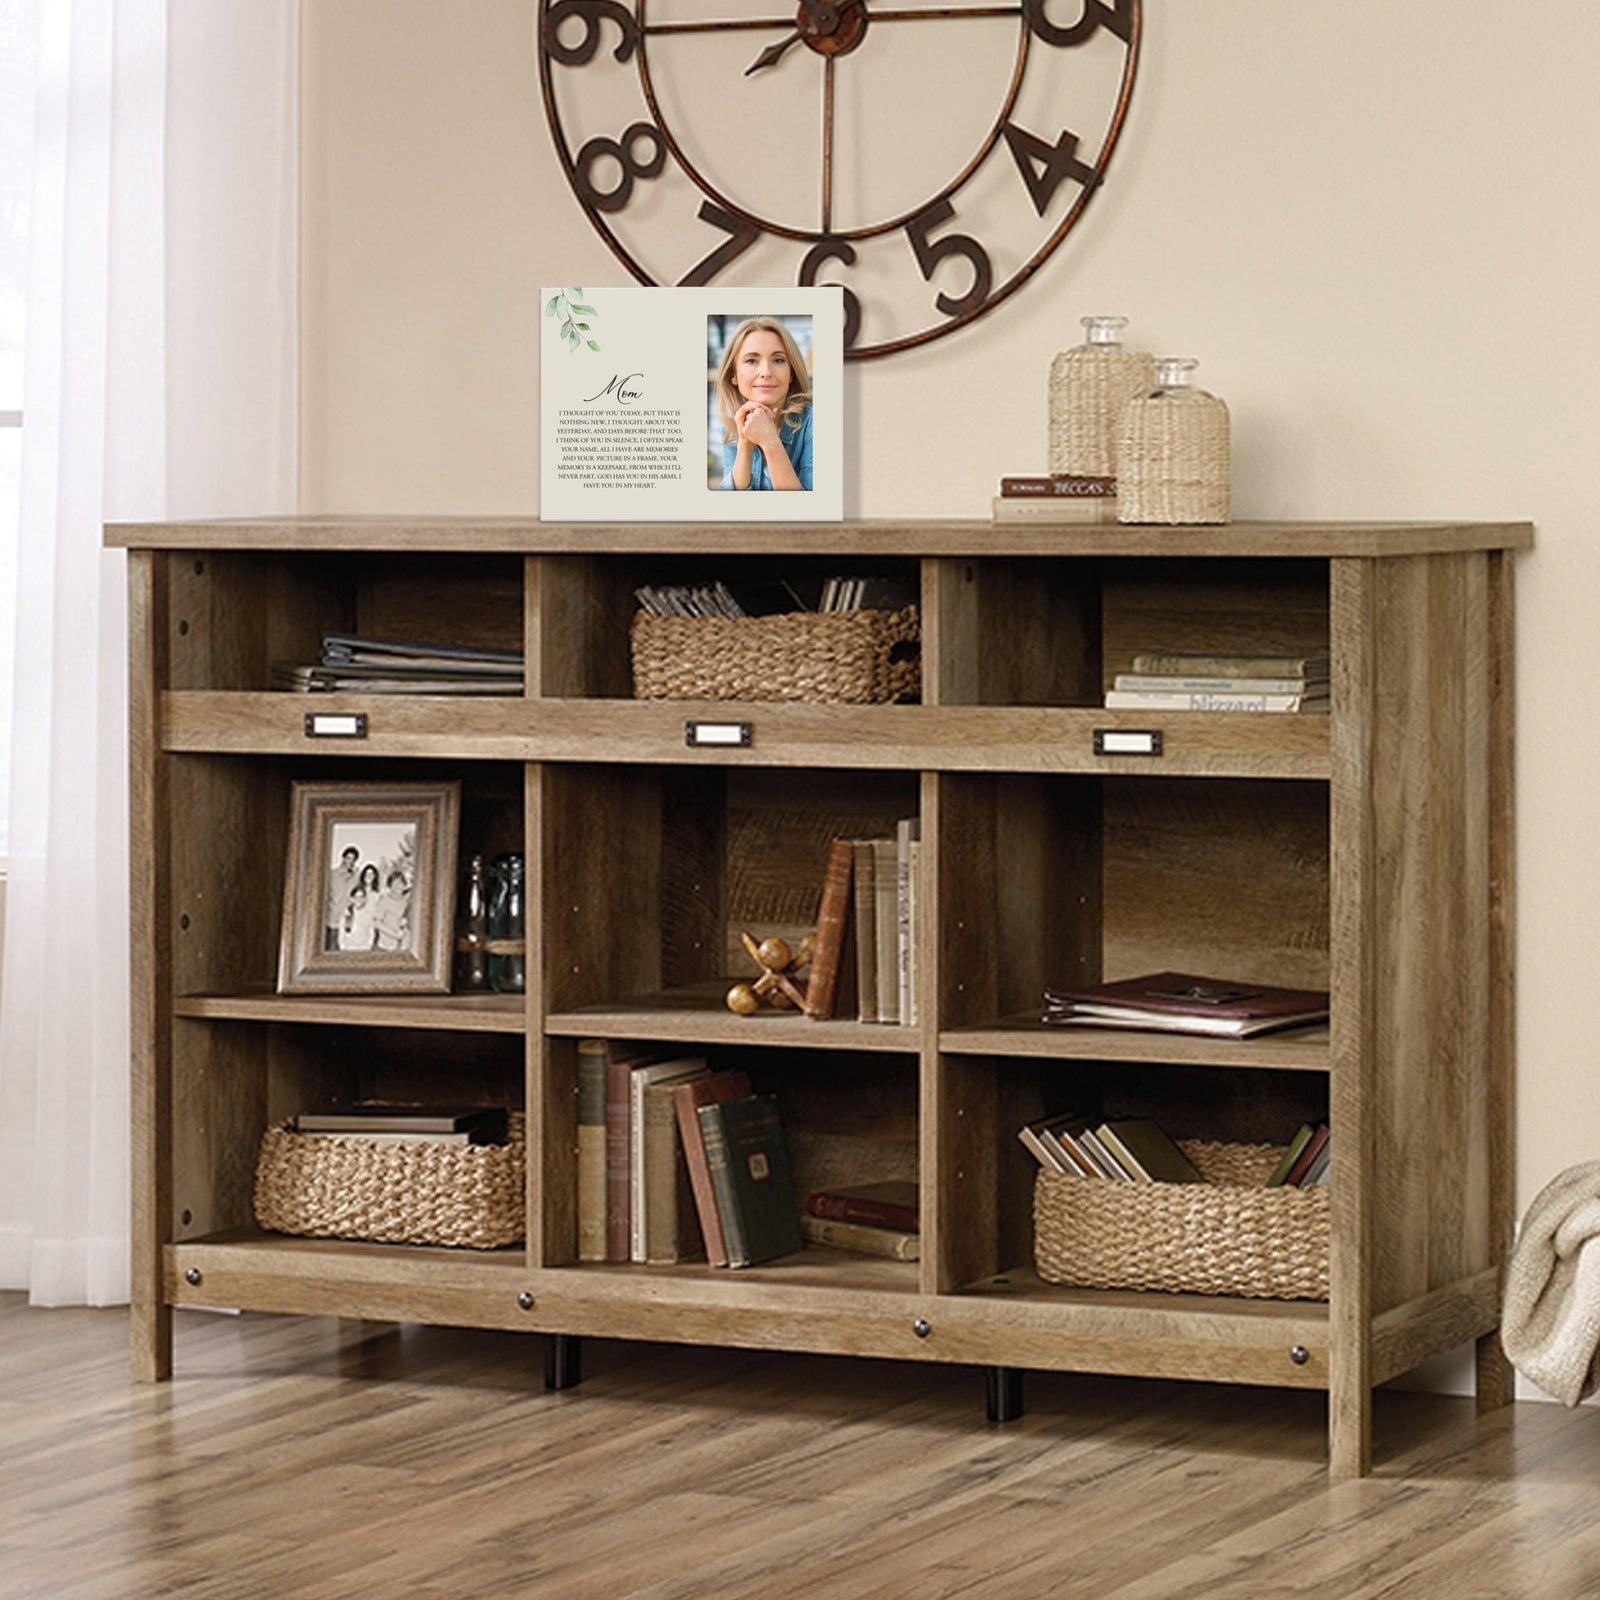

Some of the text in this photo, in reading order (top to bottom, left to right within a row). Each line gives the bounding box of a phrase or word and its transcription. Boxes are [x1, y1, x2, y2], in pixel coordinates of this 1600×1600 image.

[575, 121, 668, 212] 8
[1003, 120, 1103, 217] 4
[672, 200, 760, 287] 7
[903, 199, 992, 317] 5
[583, 373, 644, 405] Mom
[1189, 693, 1266, 711] blizzard
